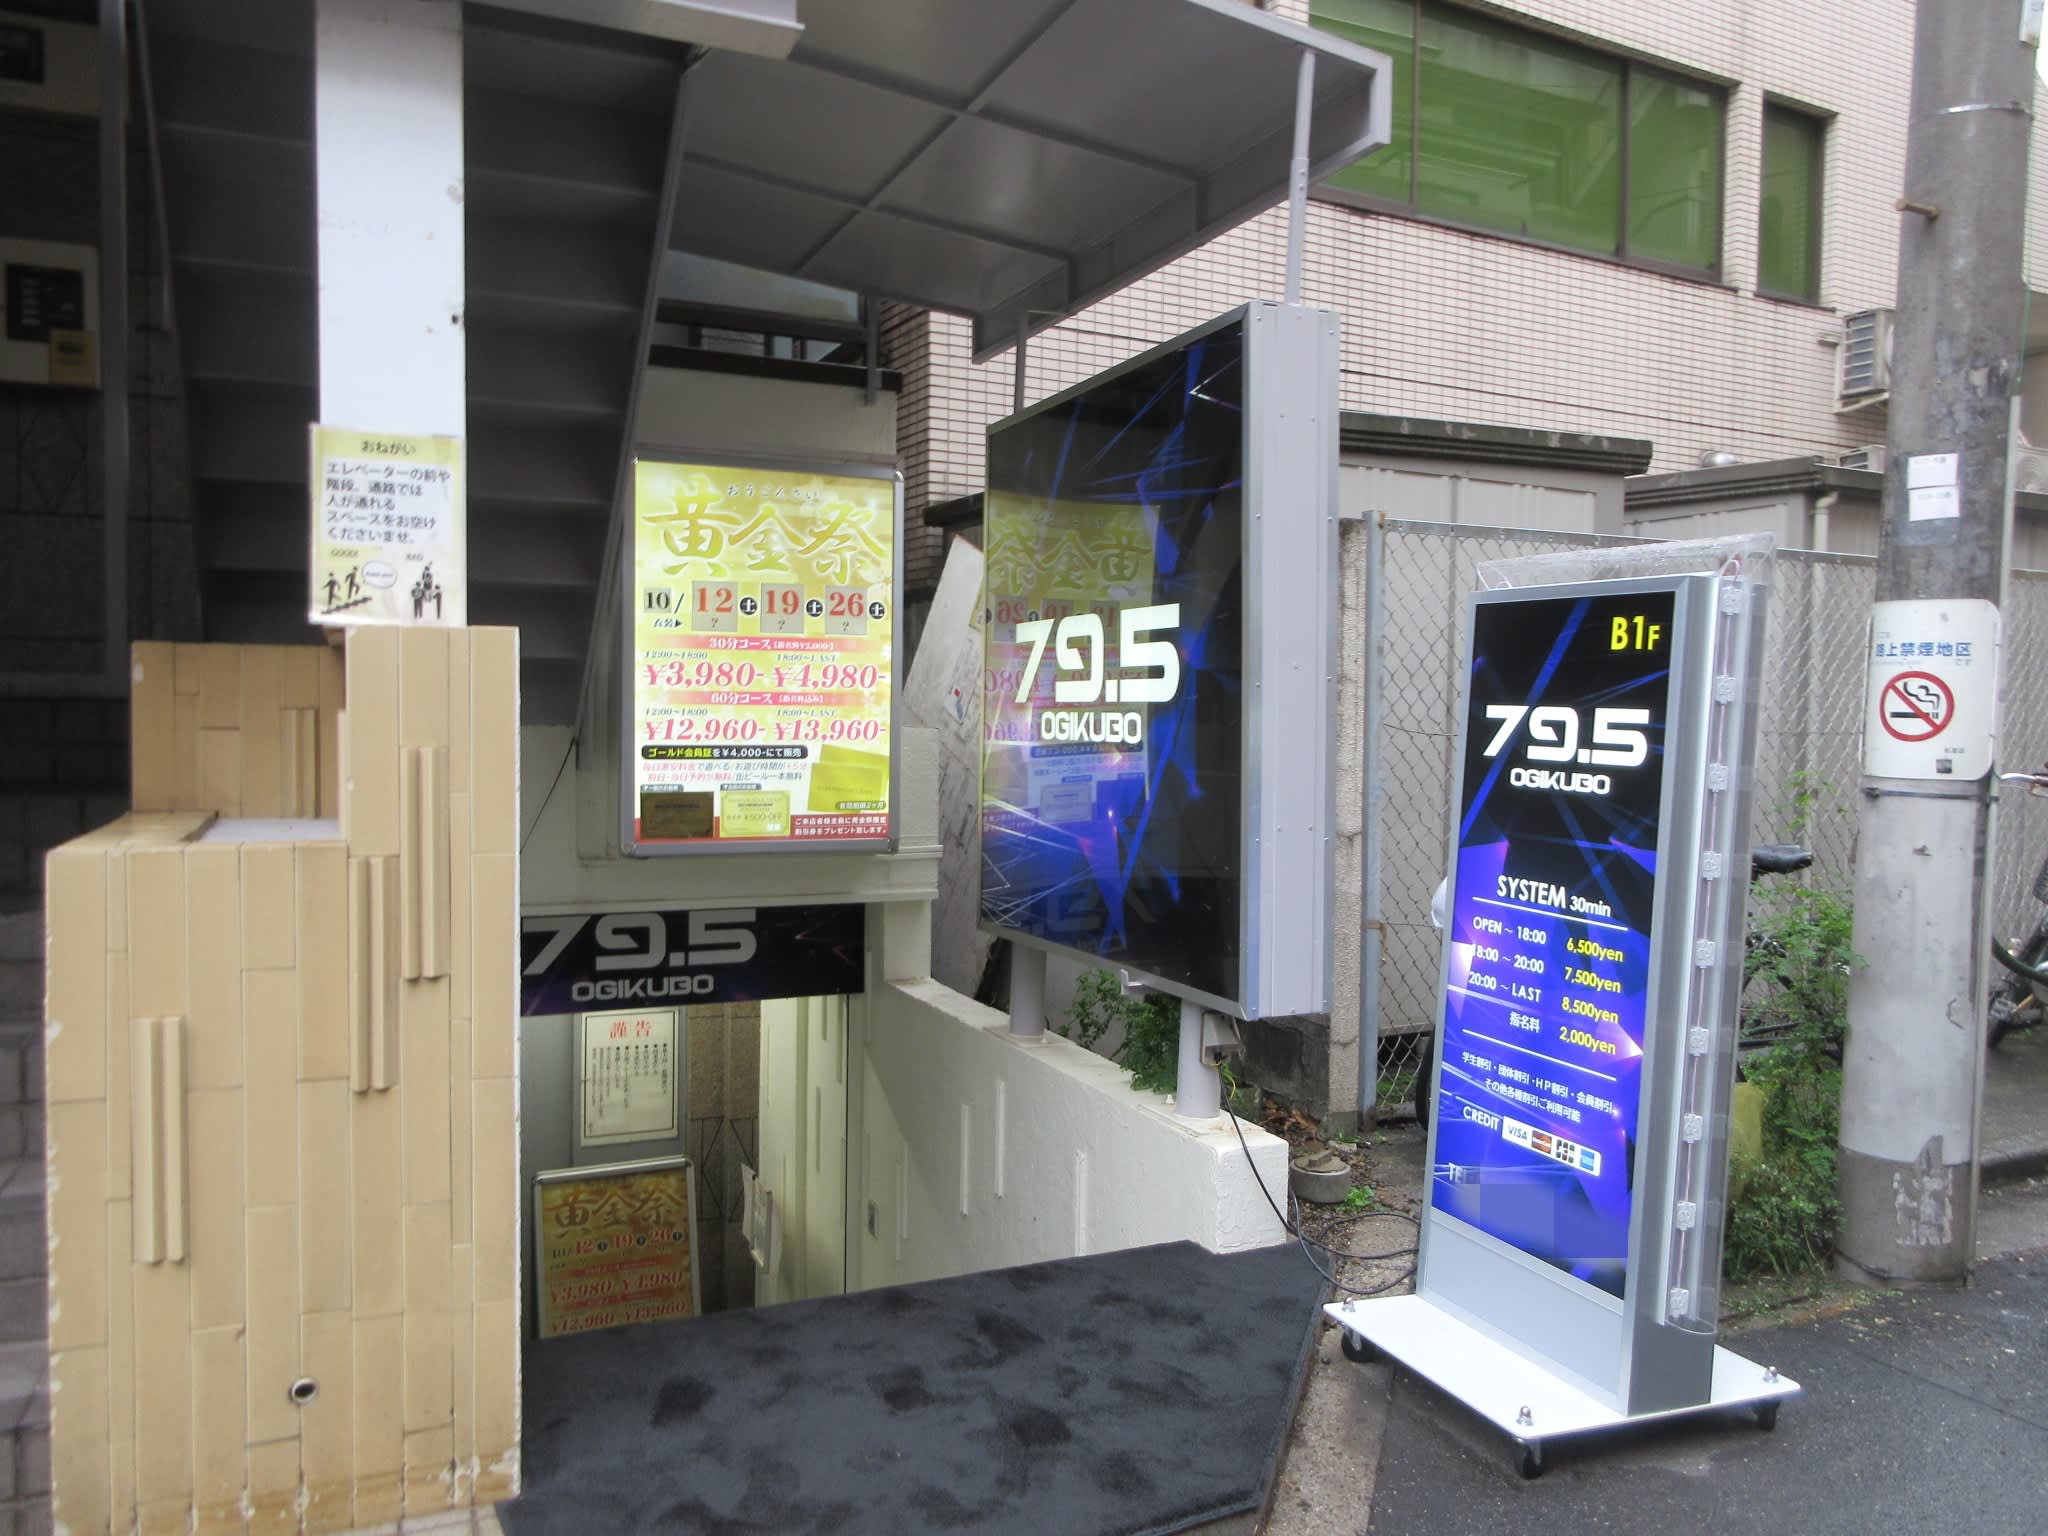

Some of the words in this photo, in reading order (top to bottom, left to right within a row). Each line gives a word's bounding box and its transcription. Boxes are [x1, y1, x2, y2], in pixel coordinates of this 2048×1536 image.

[361, 440, 416, 455] おねがい
[327, 463, 450, 483] エレベーターの前や
[641, 474, 887, 585] 黄金祭
[696, 587, 733, 613] 12
[765, 589, 800, 615] 19
[829, 591, 865, 618] 26
[1015, 602, 1181, 703] 79.5
[1040, 711, 1142, 745] OGIKUBO
[1483, 704, 1650, 767] 79.5
[1510, 767, 1611, 795] OGIKUBO
[1496, 875, 1567, 909] SYSTEM
[1569, 895, 1612, 918] 30min
[522, 908, 757, 977] 79.5
[1472, 915, 1503, 936] OPEN
[1516, 925, 1547, 945] 18:00
[1471, 943, 1499, 963] 18:00
[1514, 954, 1545, 974] 20:00
[1566, 937, 1624, 963] 6,500yen
[571, 974, 715, 1002] OGIKUBO
[1468, 971, 1498, 991] 20:00
[1512, 983, 1542, 1003] LAST
[1564, 966, 1622, 993] 7,500yen
[1509, 1011, 1541, 1034] 指名料
[1562, 996, 1620, 1025] 8,500yen
[1559, 1025, 1617, 1056] 2,000yen
[1462, 1106, 1500, 1131] CREDIT
[1507, 1125, 1528, 1141] VISA
